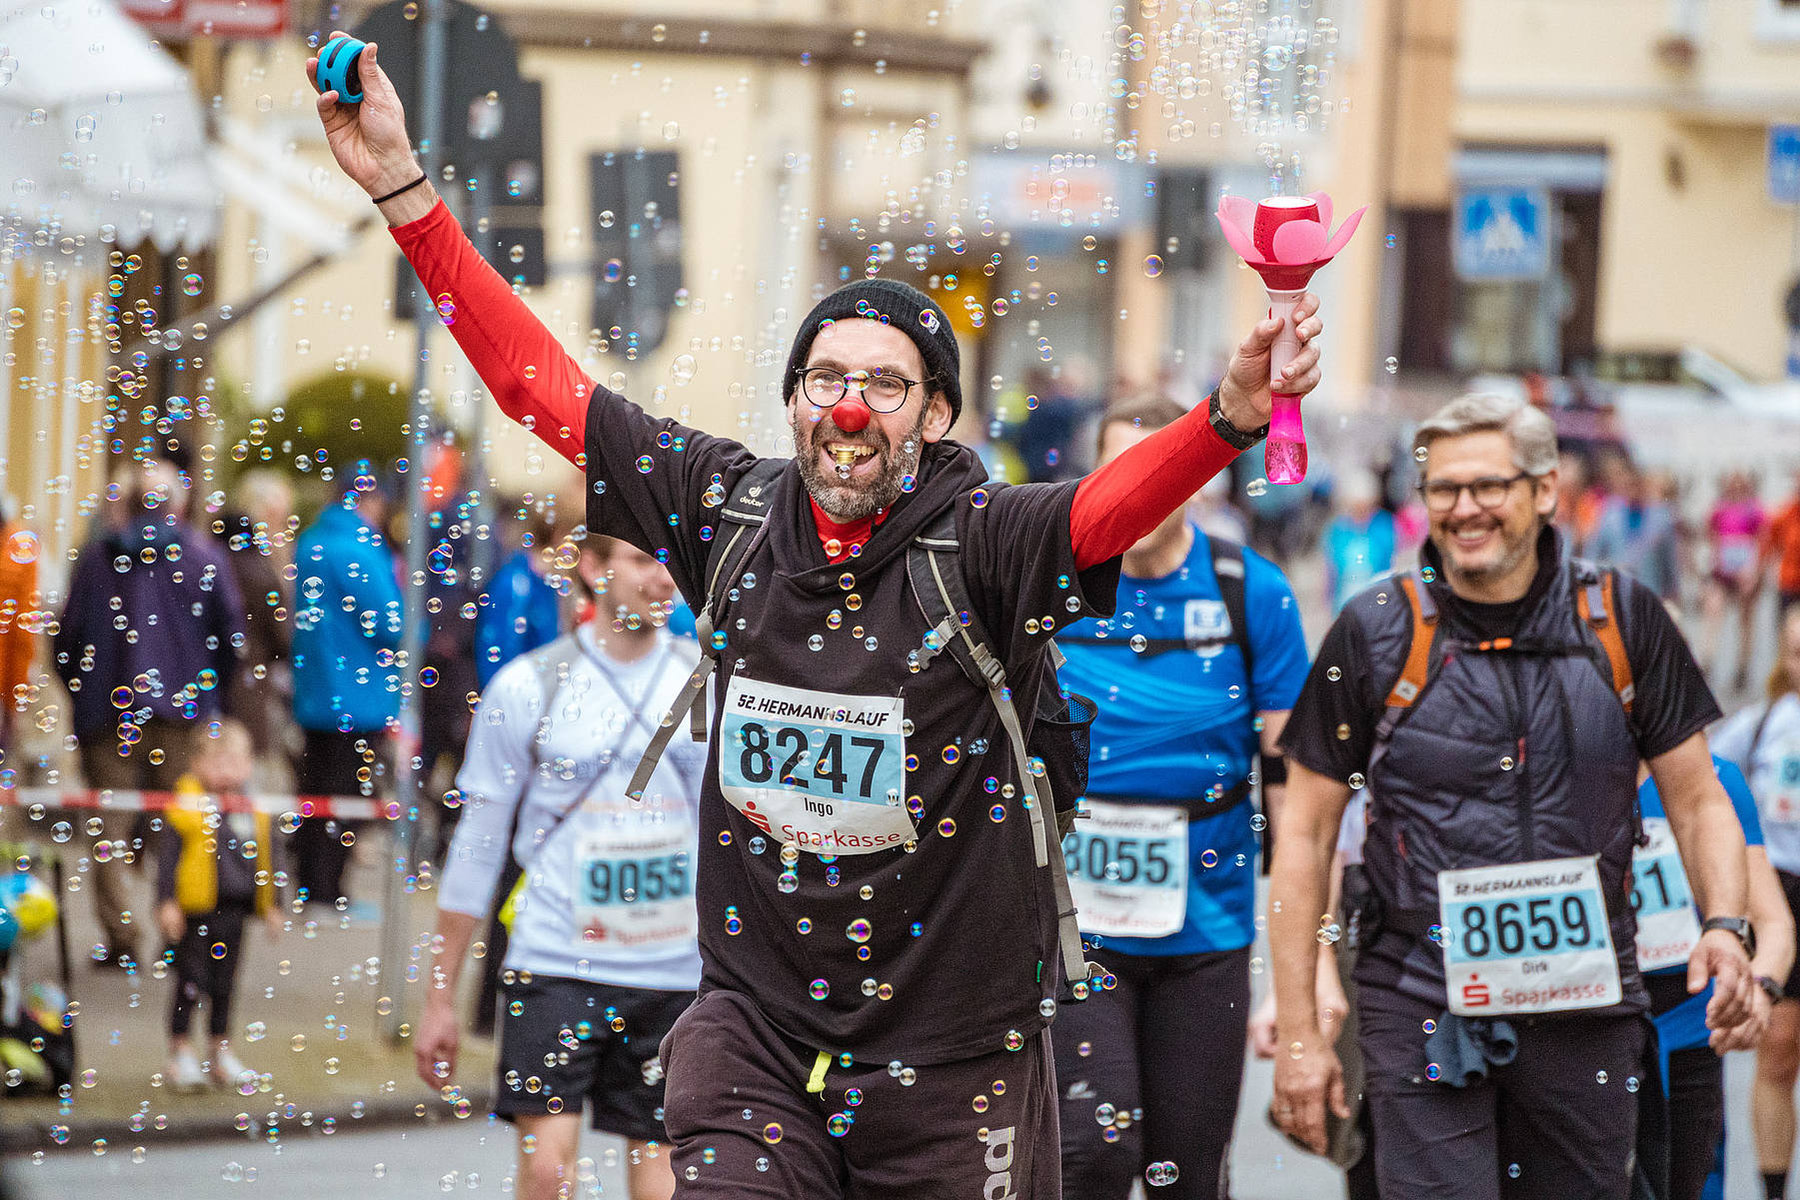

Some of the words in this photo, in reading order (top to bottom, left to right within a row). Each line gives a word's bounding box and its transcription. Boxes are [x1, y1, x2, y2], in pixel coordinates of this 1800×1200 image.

[740, 496, 765, 507] deuter
[740, 722, 885, 798] 8247
[804, 797, 834, 817] Ingo
[781, 824, 901, 848] Sparkasse
[1061, 833, 1169, 884] 8055
[591, 854, 687, 903] 9055
[1462, 896, 1591, 958] 8659
[1501, 983, 1607, 1007] Sparkasse
